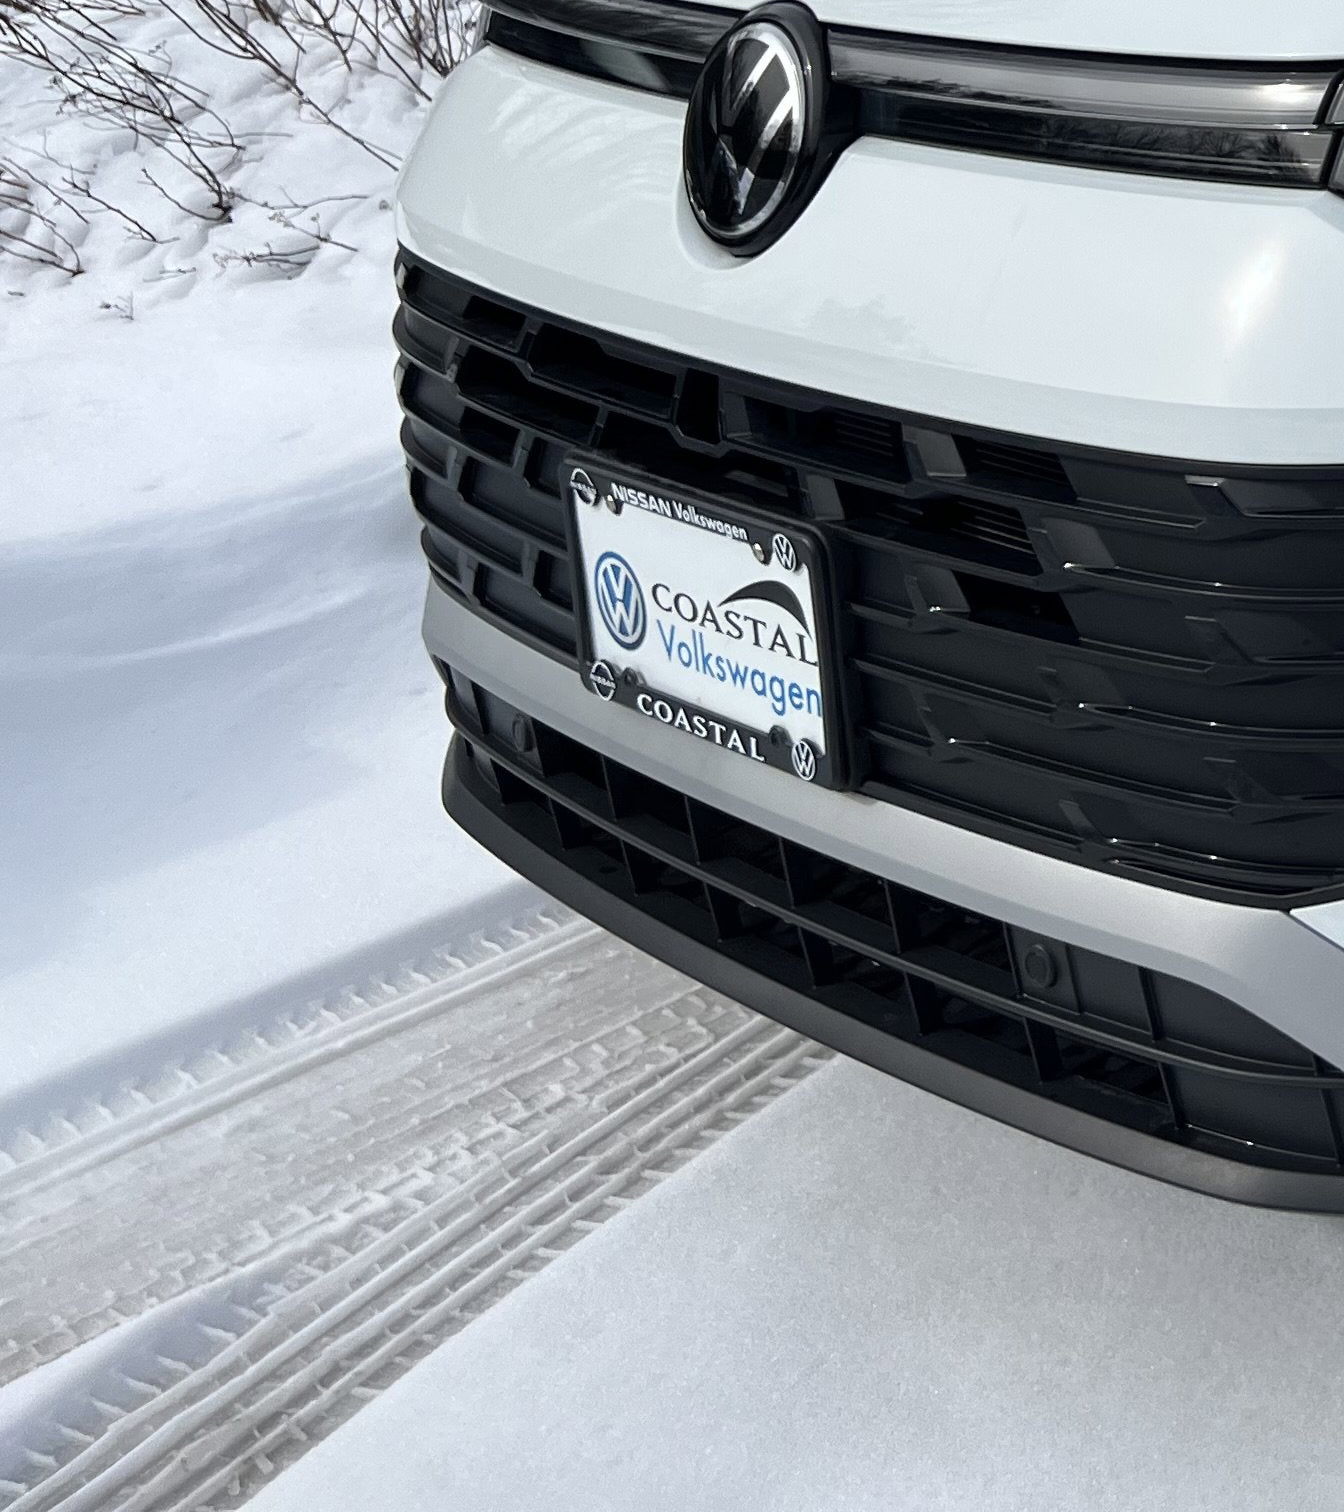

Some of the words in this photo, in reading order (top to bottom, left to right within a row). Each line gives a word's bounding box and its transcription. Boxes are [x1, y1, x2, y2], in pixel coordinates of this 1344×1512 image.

[610, 482, 672, 519] NISSAN
[673, 501, 748, 541] Volkswagen
[651, 583, 819, 667] COASTAL
[655, 619, 822, 718] Volkswagen
[637, 693, 766, 762] COASTAL
